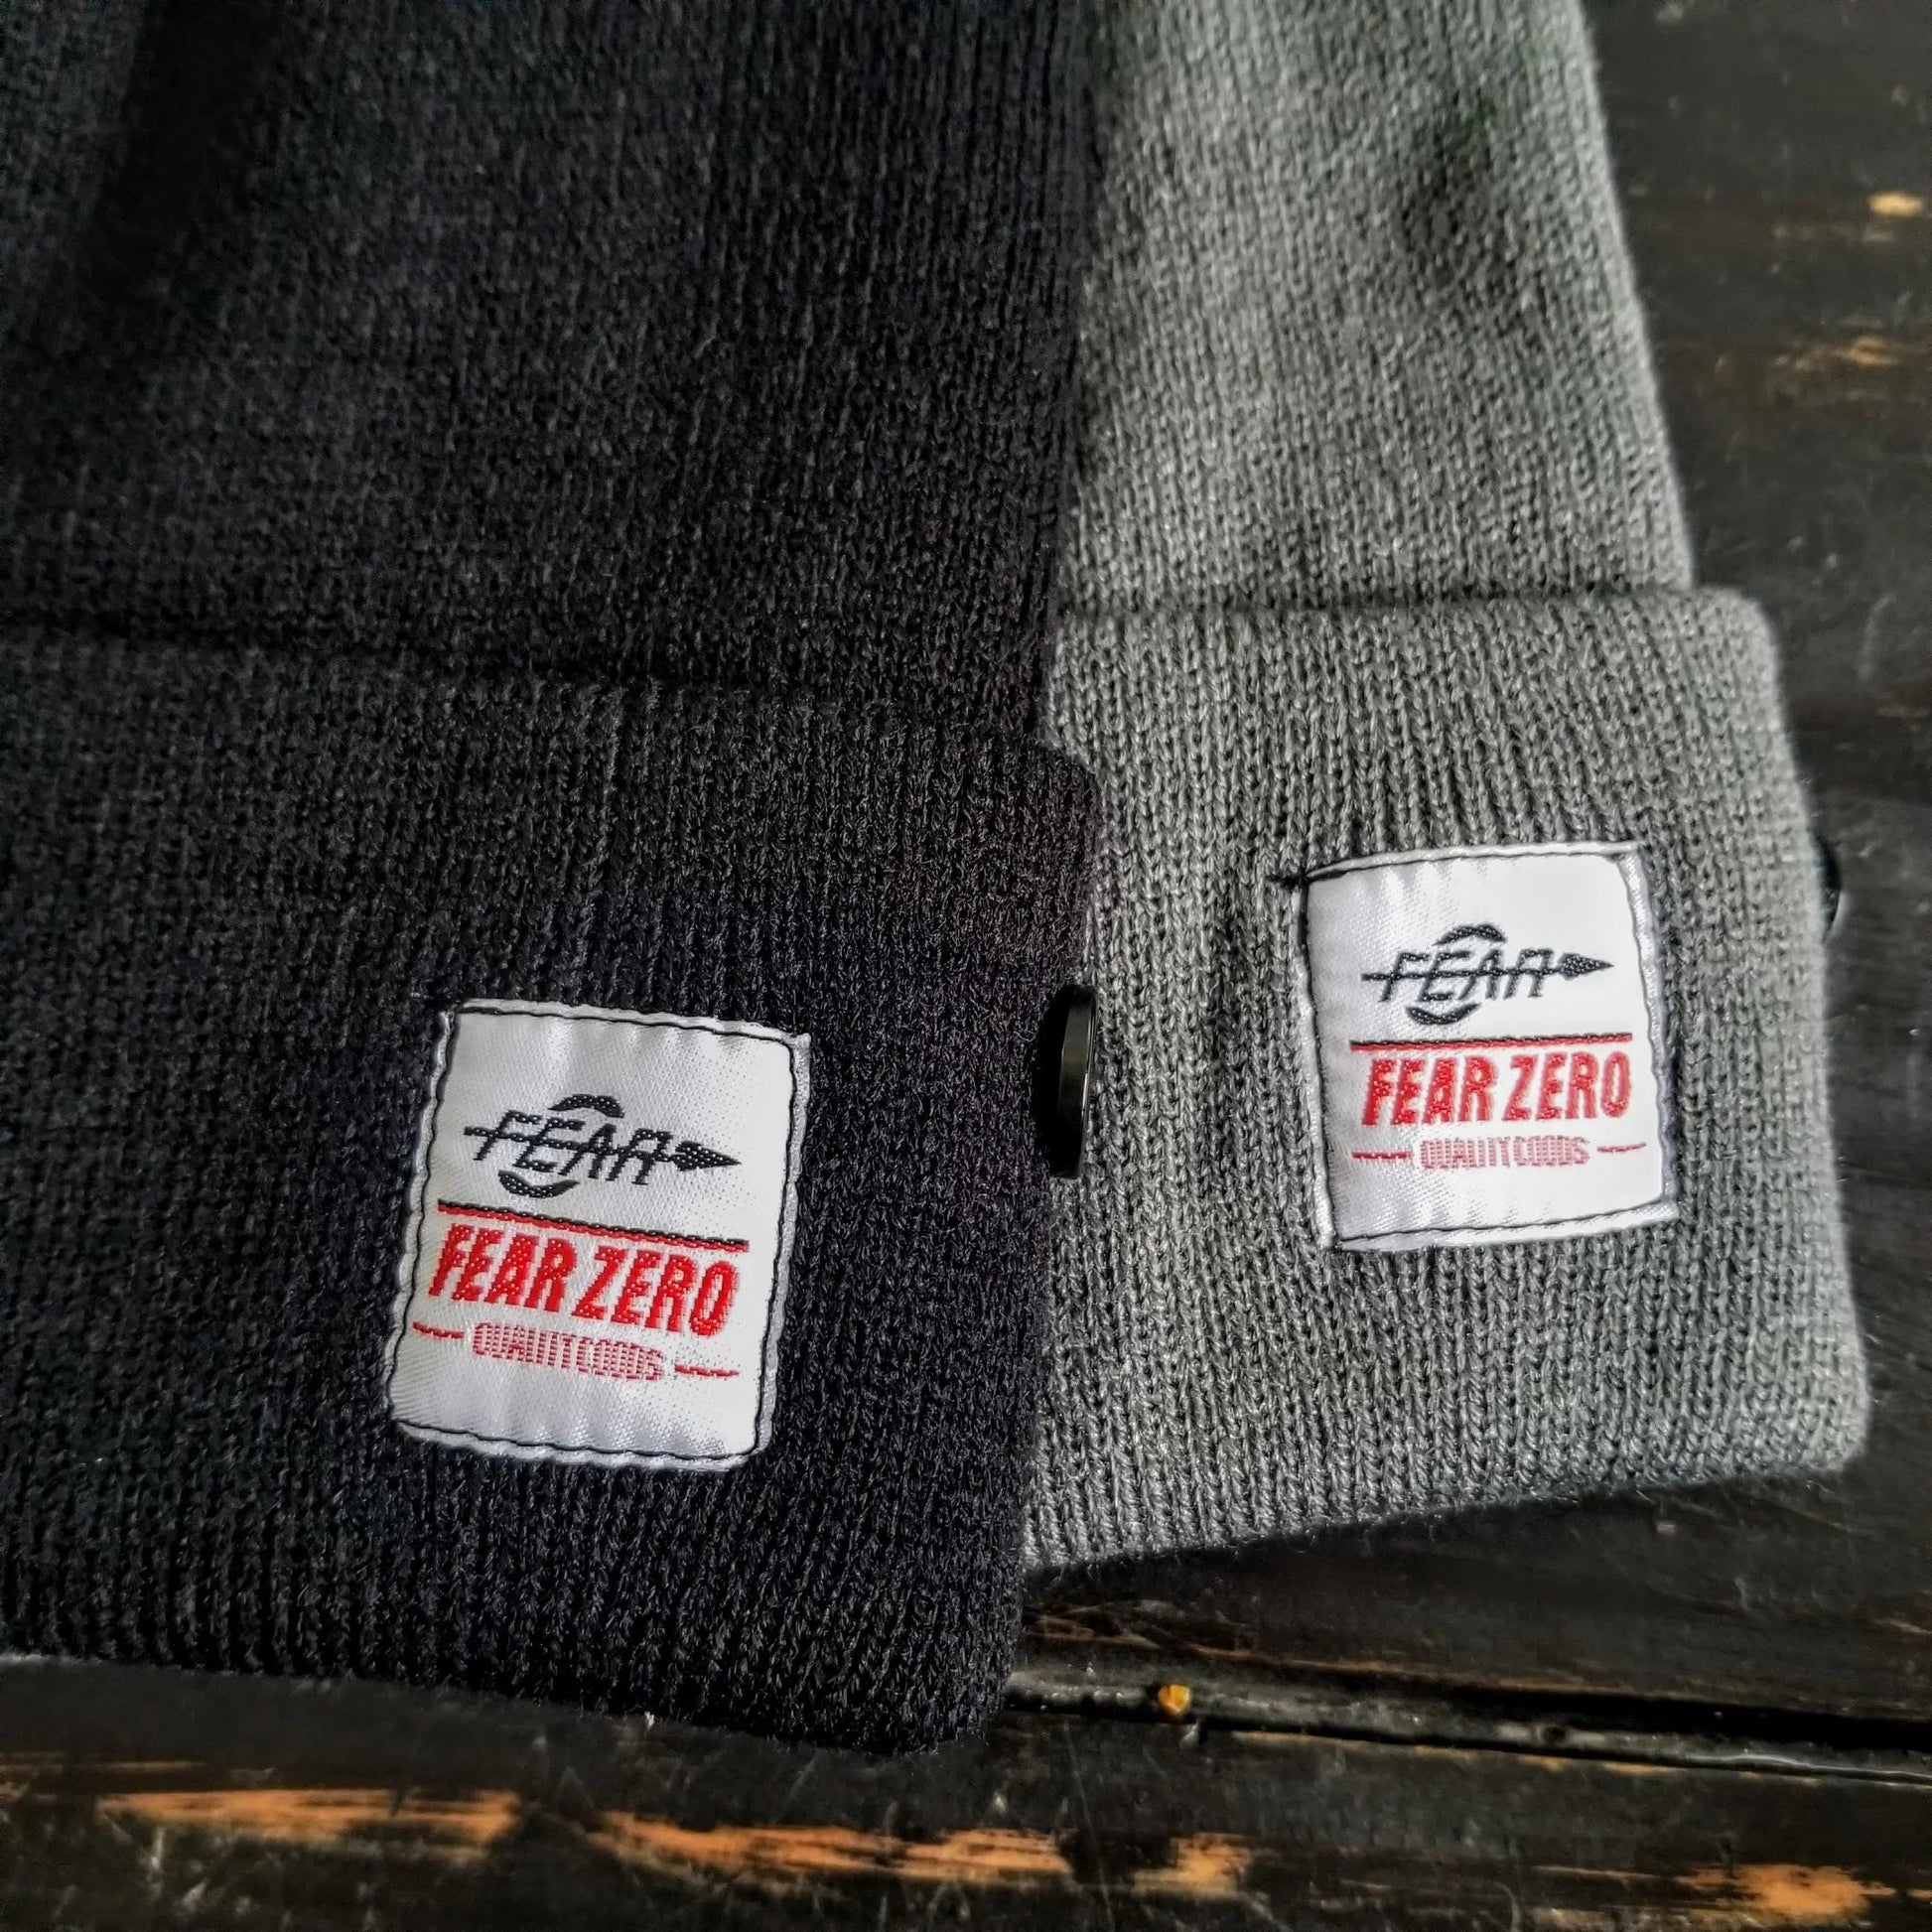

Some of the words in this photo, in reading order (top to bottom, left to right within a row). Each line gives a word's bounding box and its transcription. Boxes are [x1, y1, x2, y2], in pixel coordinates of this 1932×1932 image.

[1361, 1055, 1498, 1127] FEAR
[1502, 1051, 1632, 1122] ZERO
[428, 1223, 579, 1312] FEAR
[571, 1245, 739, 1336] ZERO
